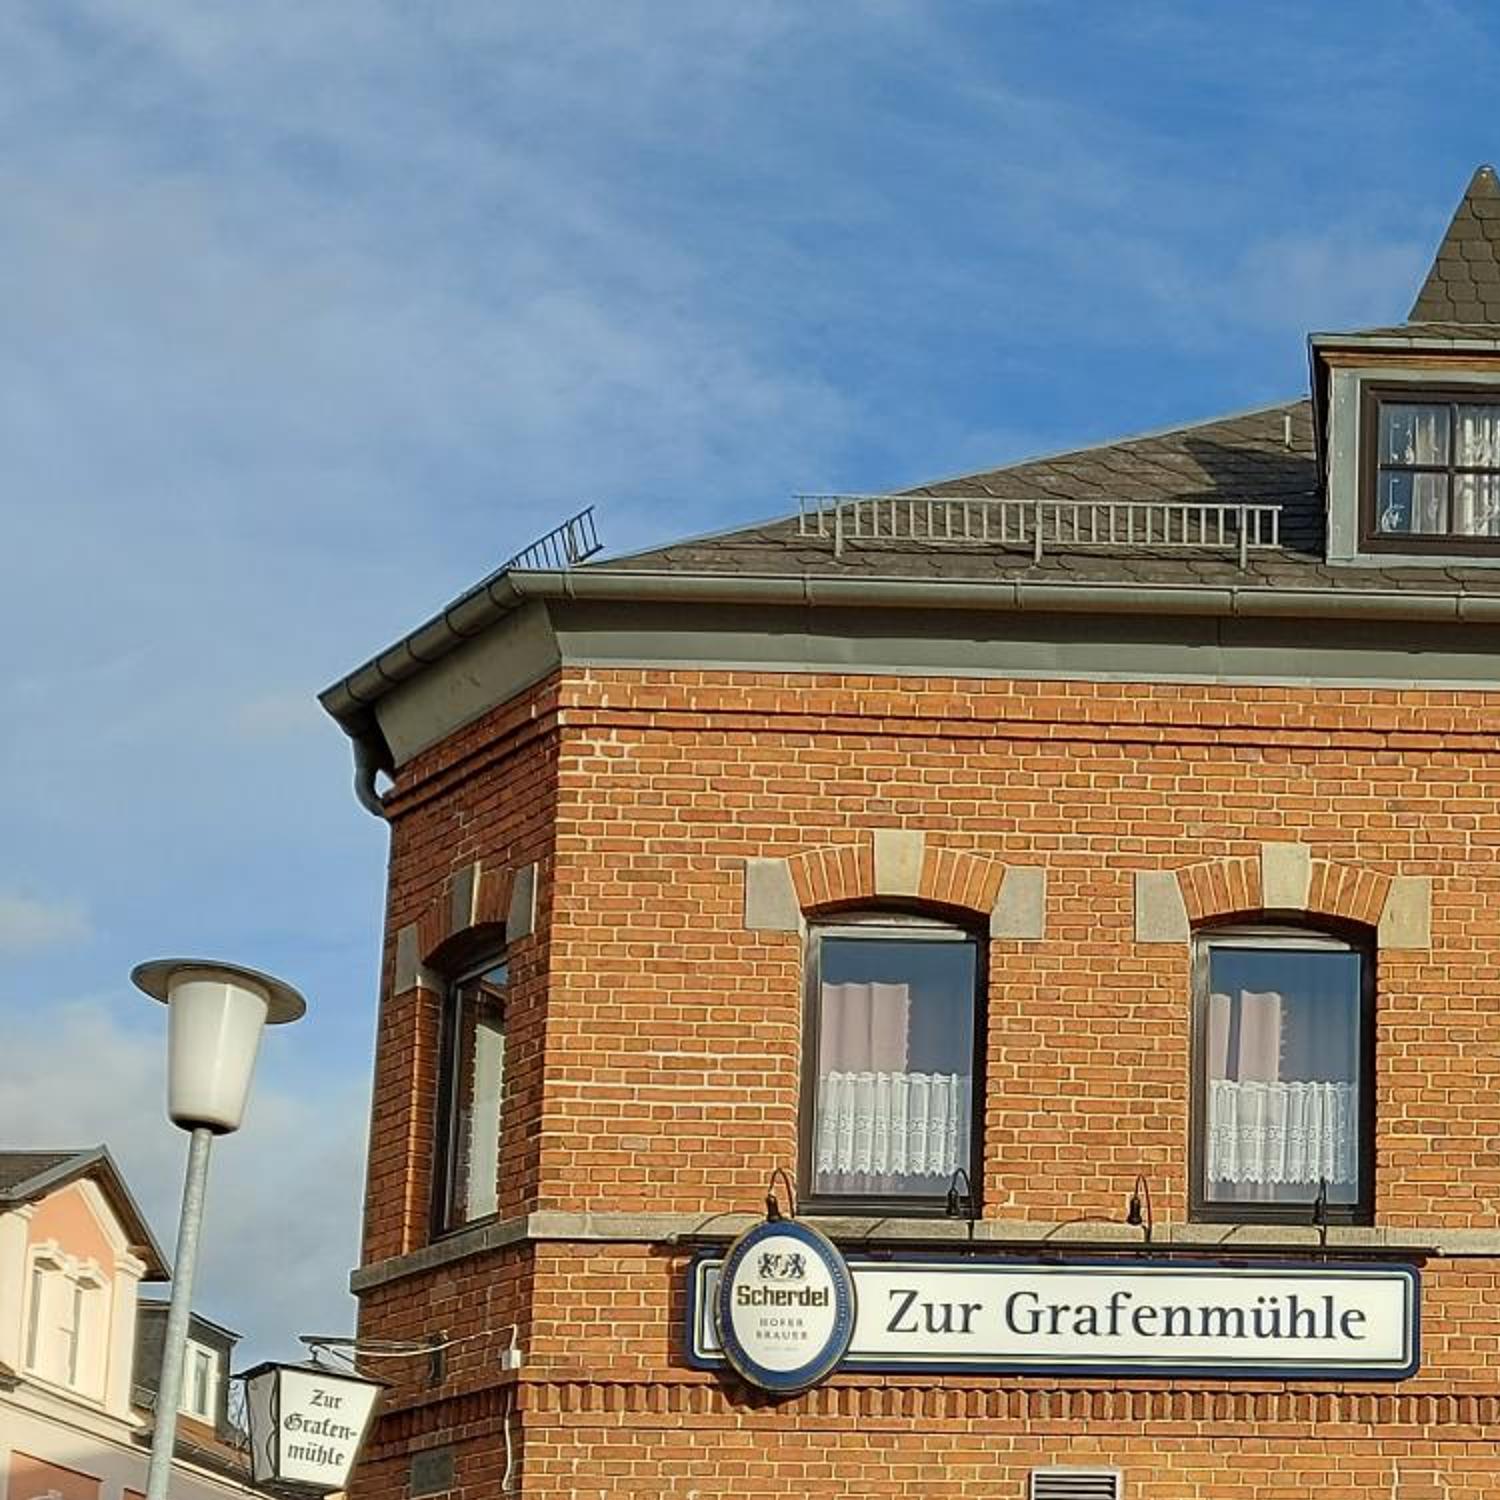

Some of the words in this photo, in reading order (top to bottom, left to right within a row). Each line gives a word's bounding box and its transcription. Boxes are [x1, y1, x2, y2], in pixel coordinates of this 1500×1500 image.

[737, 1285, 829, 1307] Scherdel
[886, 1289, 982, 1334] Zur
[1005, 1290, 1368, 1341] Grafenmühle
[309, 1388, 343, 1409] Zur
[283, 1412, 358, 1441] Grafen-
[287, 1441, 345, 1467] mühle
